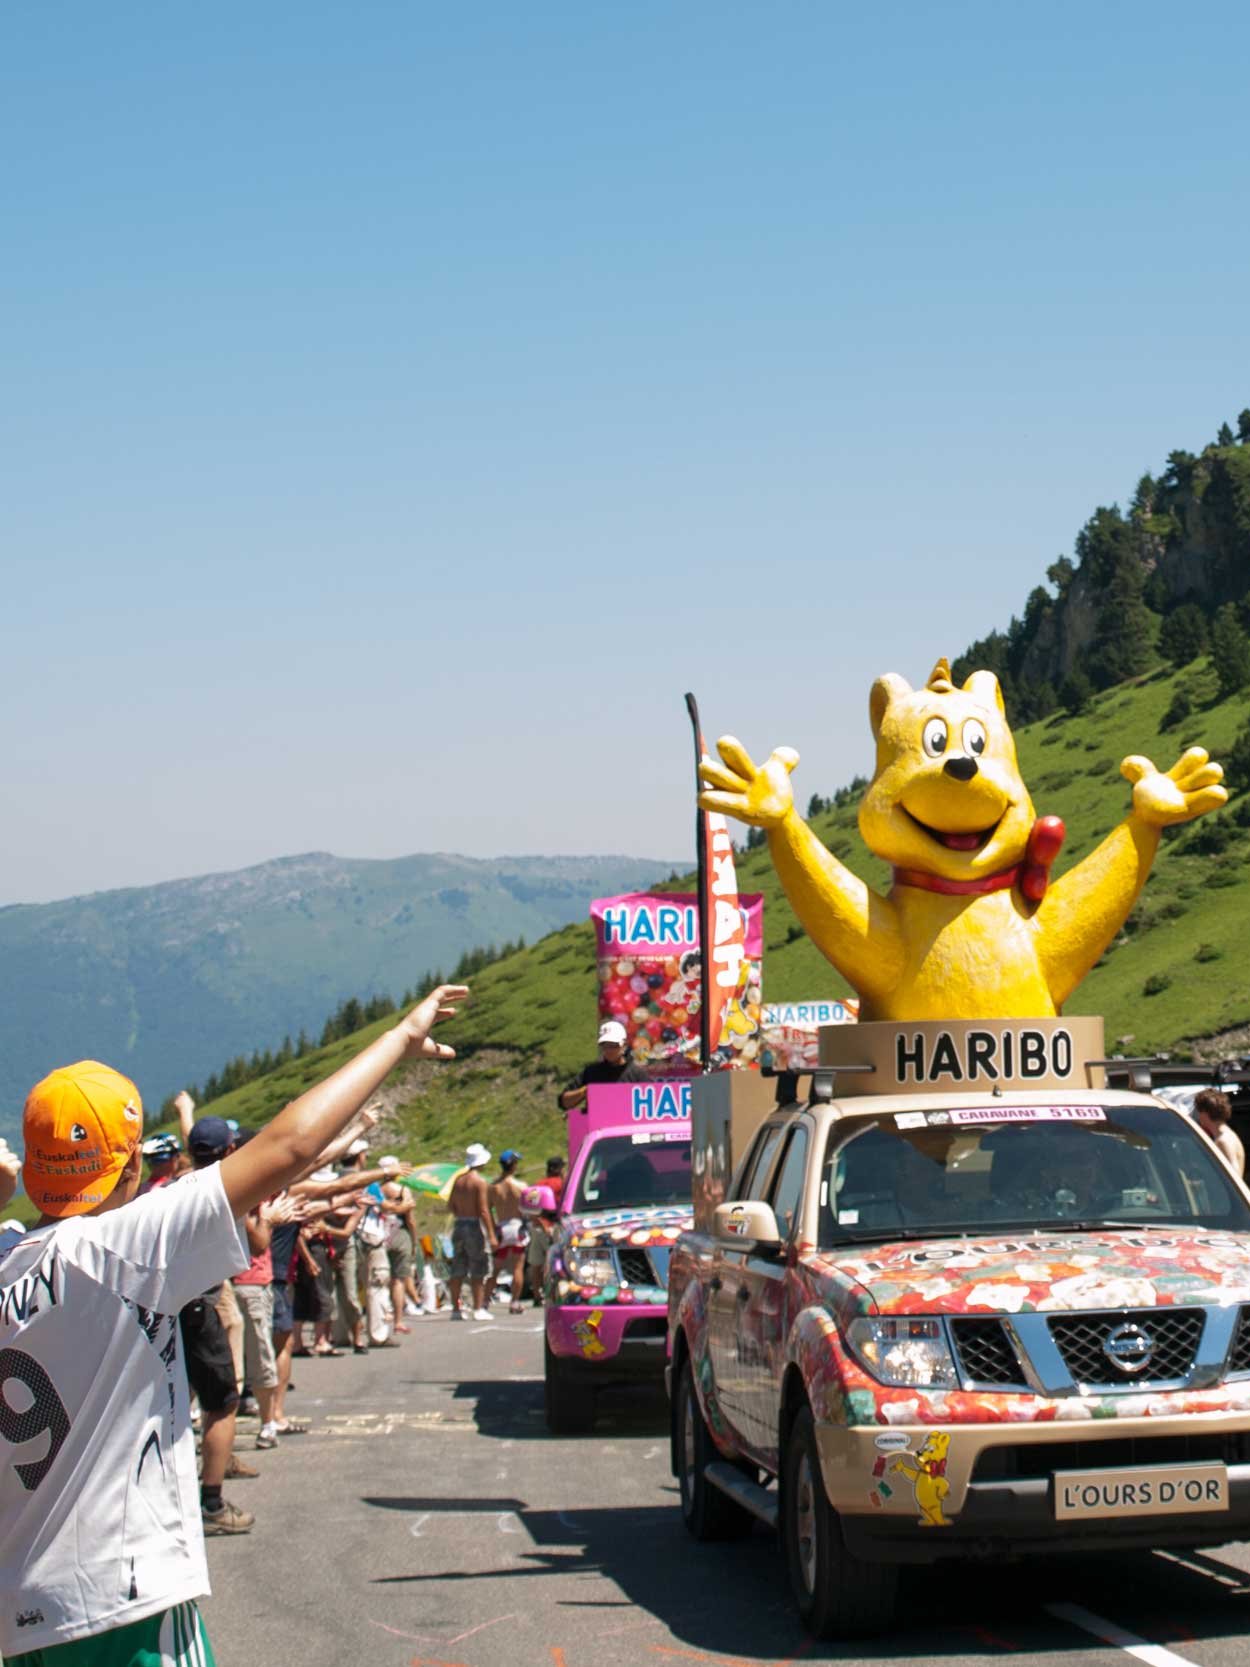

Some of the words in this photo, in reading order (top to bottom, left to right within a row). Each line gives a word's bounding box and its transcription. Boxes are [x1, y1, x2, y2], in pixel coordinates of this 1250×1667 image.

[896, 1030, 1073, 1083] HARIBO
[958, 1110, 1039, 1121] CARAVANE
[1049, 1106, 1101, 1119] 5169
[0, 1347, 72, 1492] 9
[1064, 1482, 1153, 1508] L'OURS
[1159, 1479, 1220, 1503] D'OR
